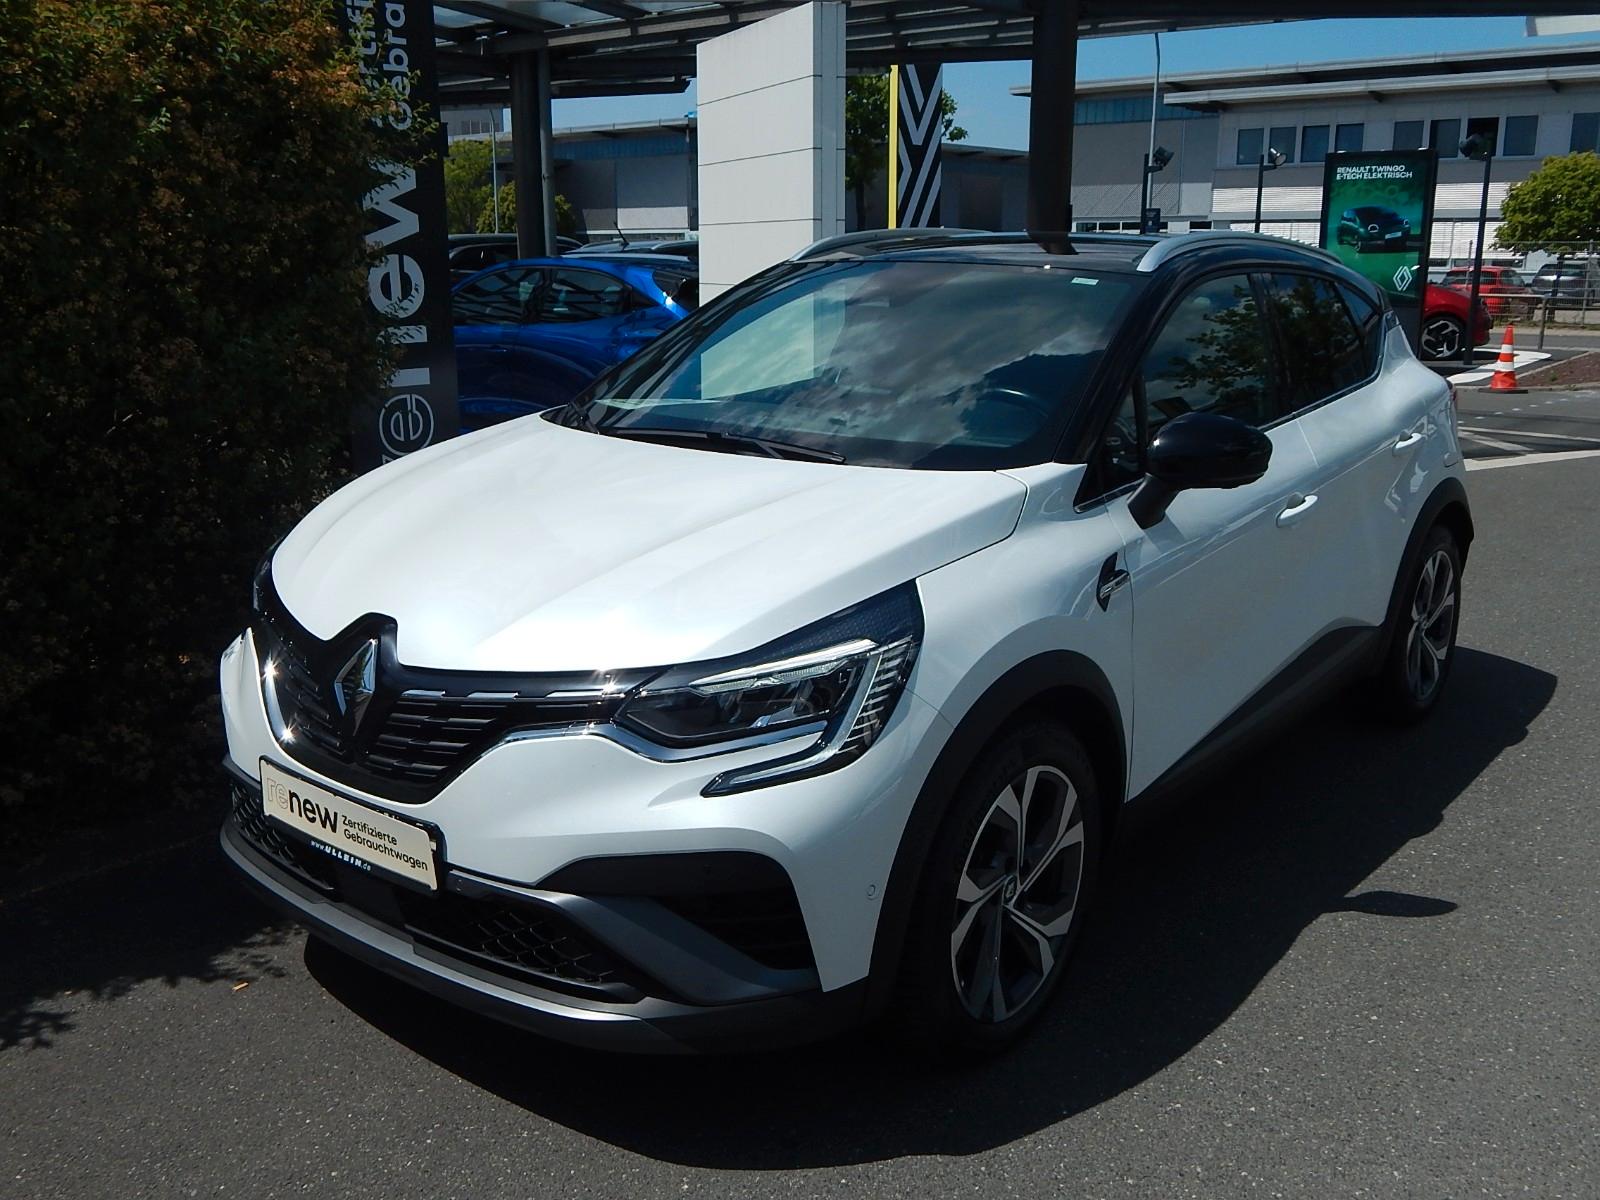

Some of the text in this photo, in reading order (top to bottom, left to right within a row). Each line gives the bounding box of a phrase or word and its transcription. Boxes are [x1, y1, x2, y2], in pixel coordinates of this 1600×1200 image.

[362, 157, 435, 465] enew
[266, 777, 338, 834] renew
[341, 814, 398, 846] Zertifizierte
[343, 829, 428, 871] Gebrauchtwagen
